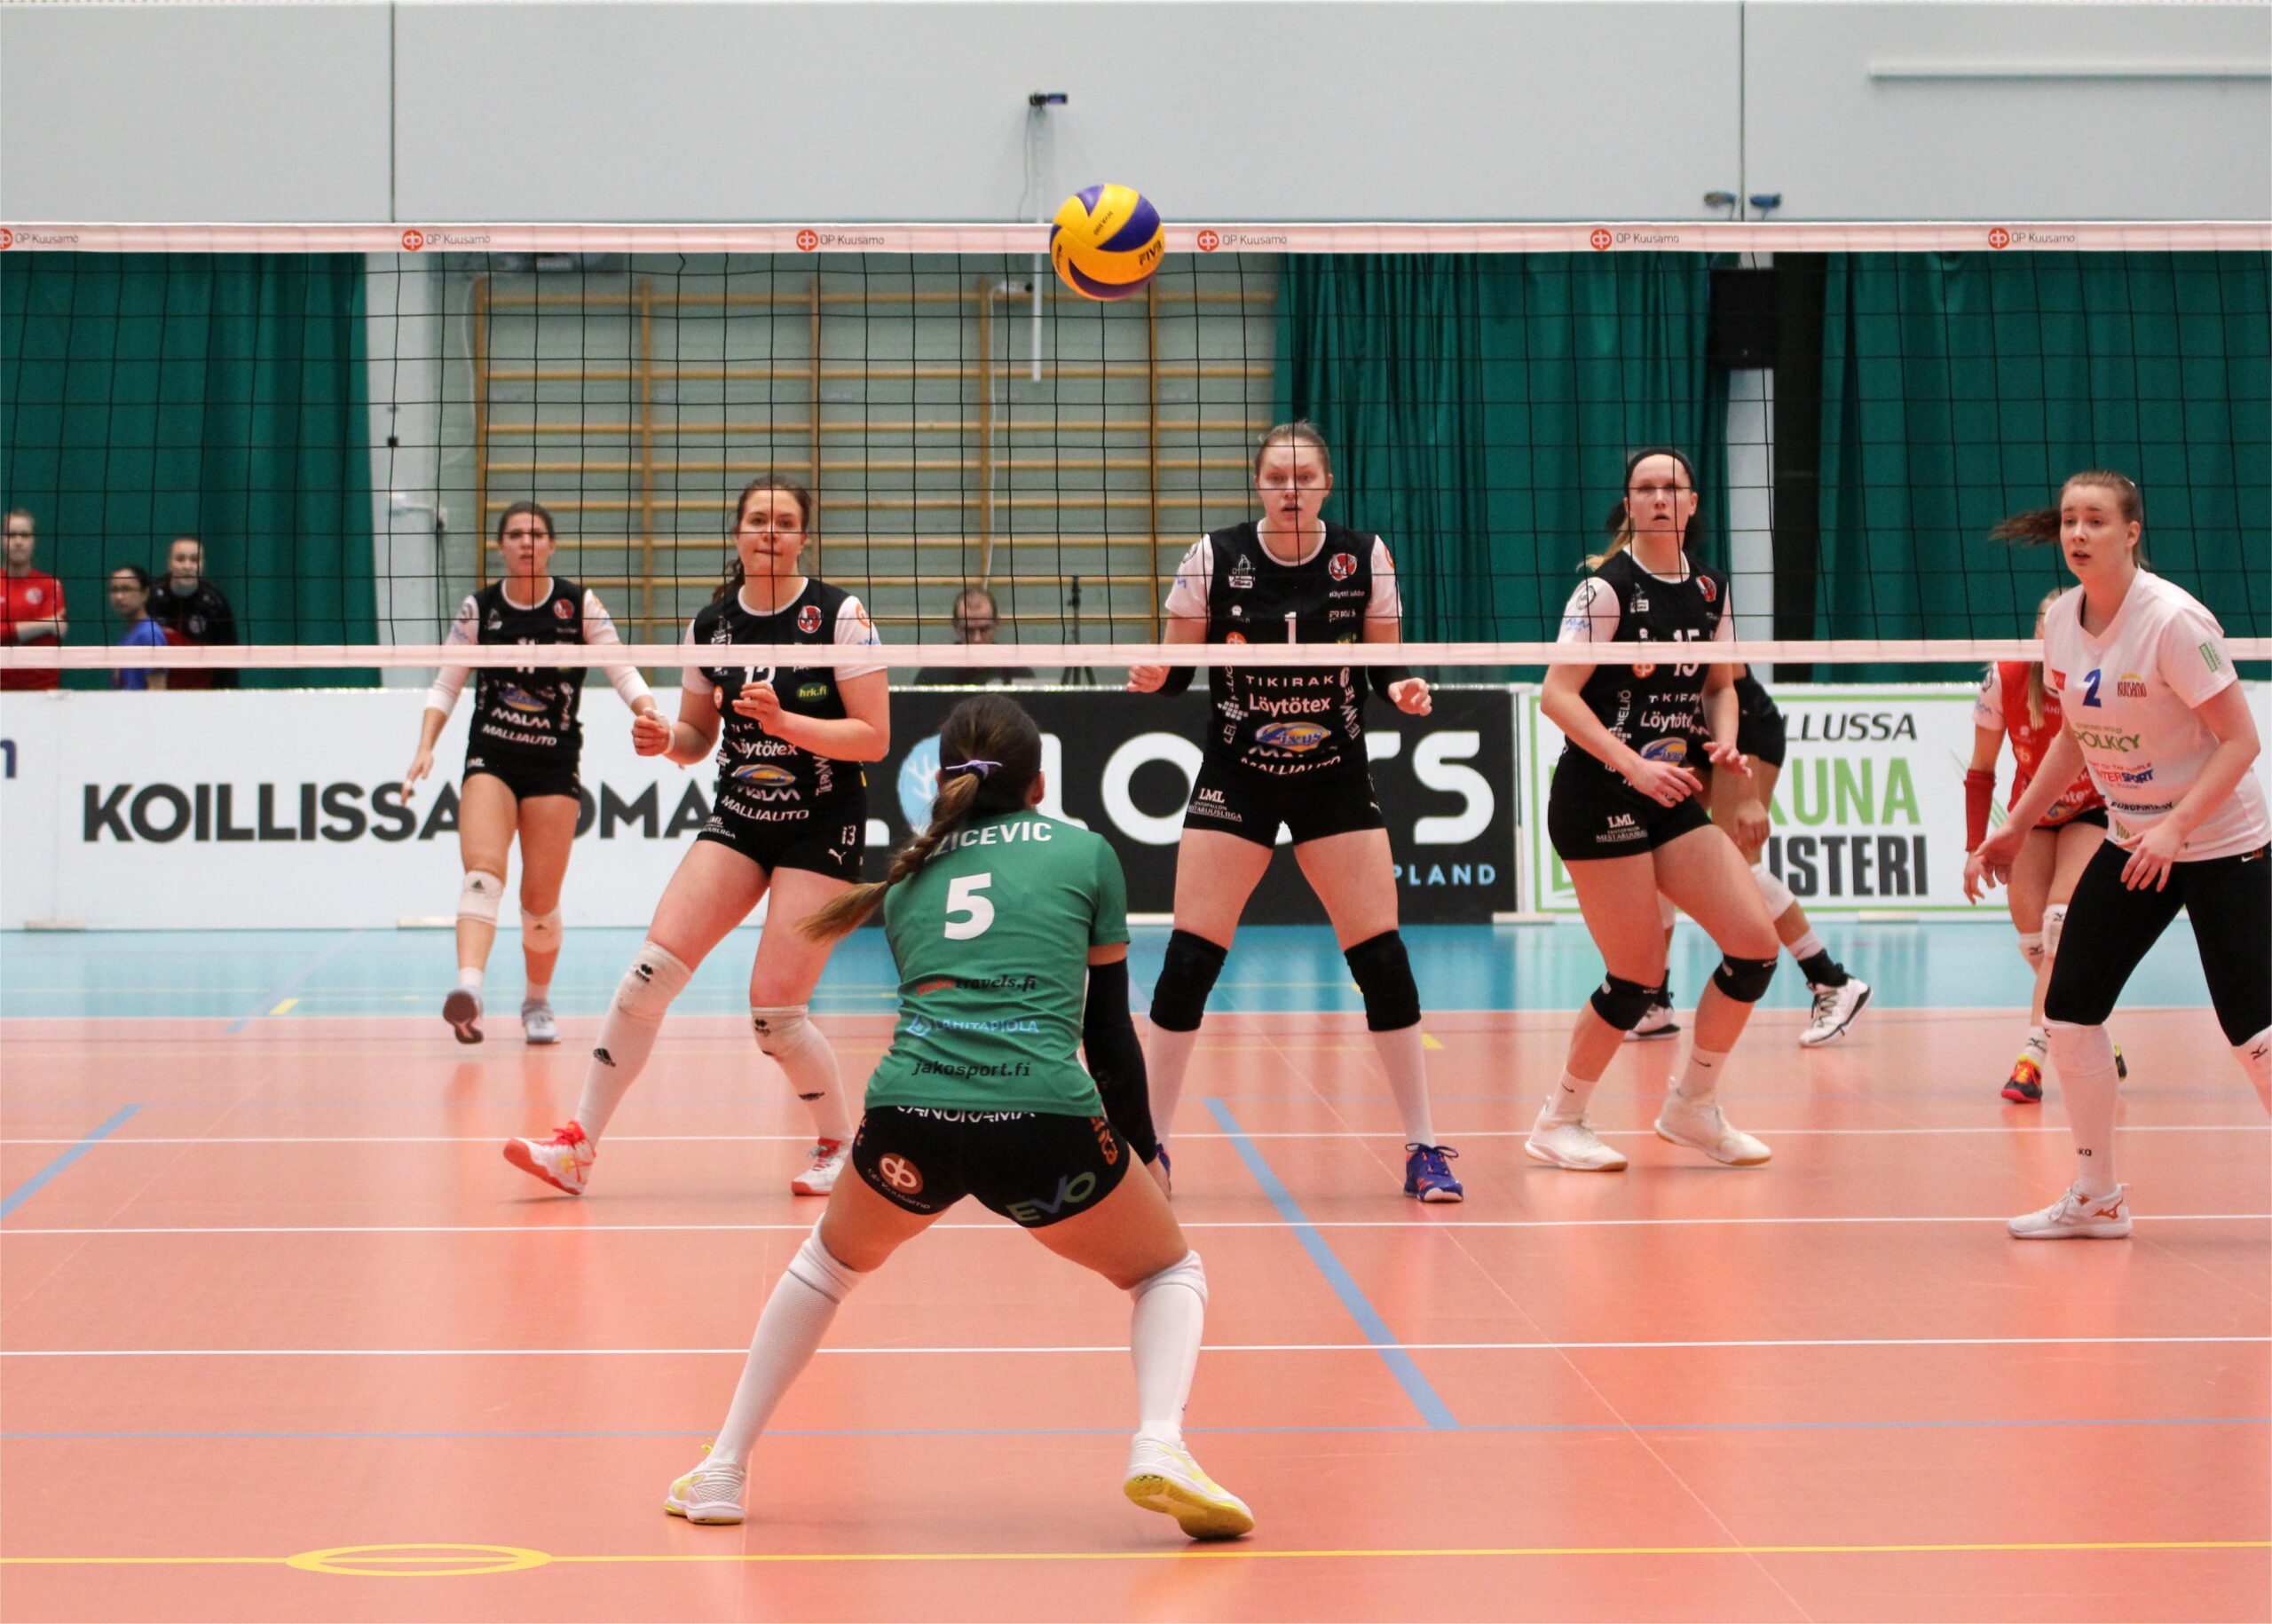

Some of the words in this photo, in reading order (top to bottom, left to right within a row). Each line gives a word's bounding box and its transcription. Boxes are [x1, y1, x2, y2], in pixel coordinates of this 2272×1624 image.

[15, 233, 29, 244] OP
[33, 233, 79, 244] Kuusamo
[427, 234, 441, 245] OP
[444, 234, 491, 245] Kuusamo
[820, 234, 835, 246] OP
[838, 234, 885, 246] Kuusamo
[1223, 235, 1237, 245] OP
[1241, 235, 1288, 245] Kuusamo
[1616, 233, 1630, 244] OP
[1634, 233, 1680, 244] Kuusamo
[2011, 233, 2026, 243] OP
[2029, 233, 2075, 243] Kuusamo
[1284, 611, 1297, 643] 1
[800, 685, 827, 698] hrk.fi
[1246, 675, 1335, 687] TIKIRAK
[2083, 668, 2102, 707] 2
[1249, 693, 1331, 718] Löytötex
[492, 707, 552, 729] MALM
[1782, 713, 1918, 742] LLUSSA
[482, 724, 557, 746] MALLIAUTO
[1199, 788, 1226, 803] LML
[721, 795, 809, 822] MALLIAUTO
[1607, 813, 1636, 829] LML
[841, 824, 856, 846] 13
[925, 822, 1053, 861] ZICEVIC
[1393, 864, 1496, 886] PLAND
[1769, 834, 1929, 897] ISTERI
[944, 872, 995, 940] 5
[911, 1060, 1030, 1079] jakosport.fi
[1006, 1171, 1096, 1222] EVO
